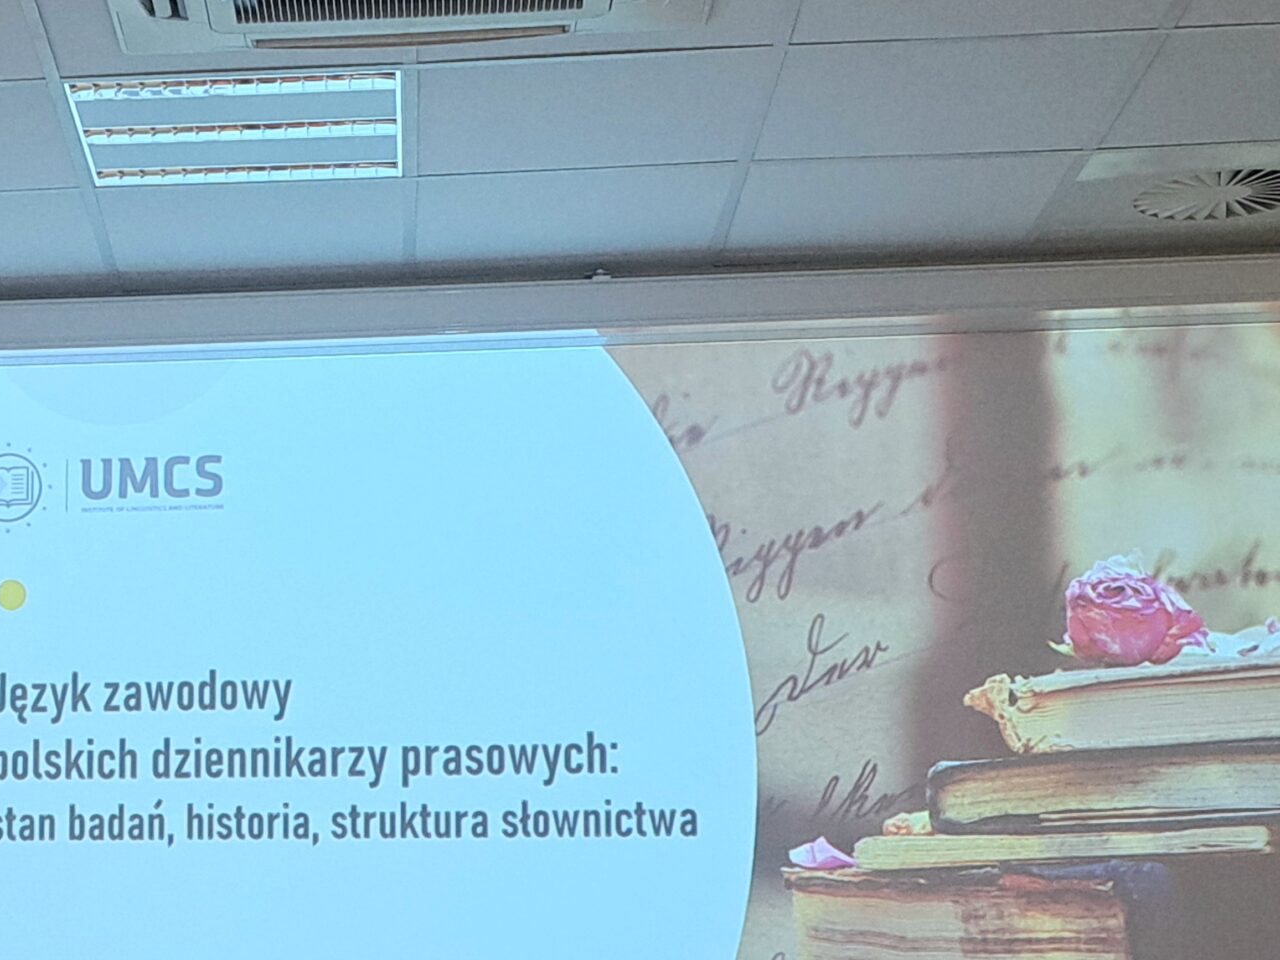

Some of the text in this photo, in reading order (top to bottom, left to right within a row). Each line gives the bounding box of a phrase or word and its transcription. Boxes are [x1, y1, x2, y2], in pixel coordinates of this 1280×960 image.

[80, 455, 223, 500] UMCS
[103, 669, 293, 721] zawodowy
[151, 735, 388, 788] dziennikarzy
[401, 731, 619, 787] prasowych:
[68, 798, 174, 848] badań,
[186, 802, 320, 847] historia,
[330, 800, 489, 840] struktura
[501, 798, 698, 839] słownictwa
